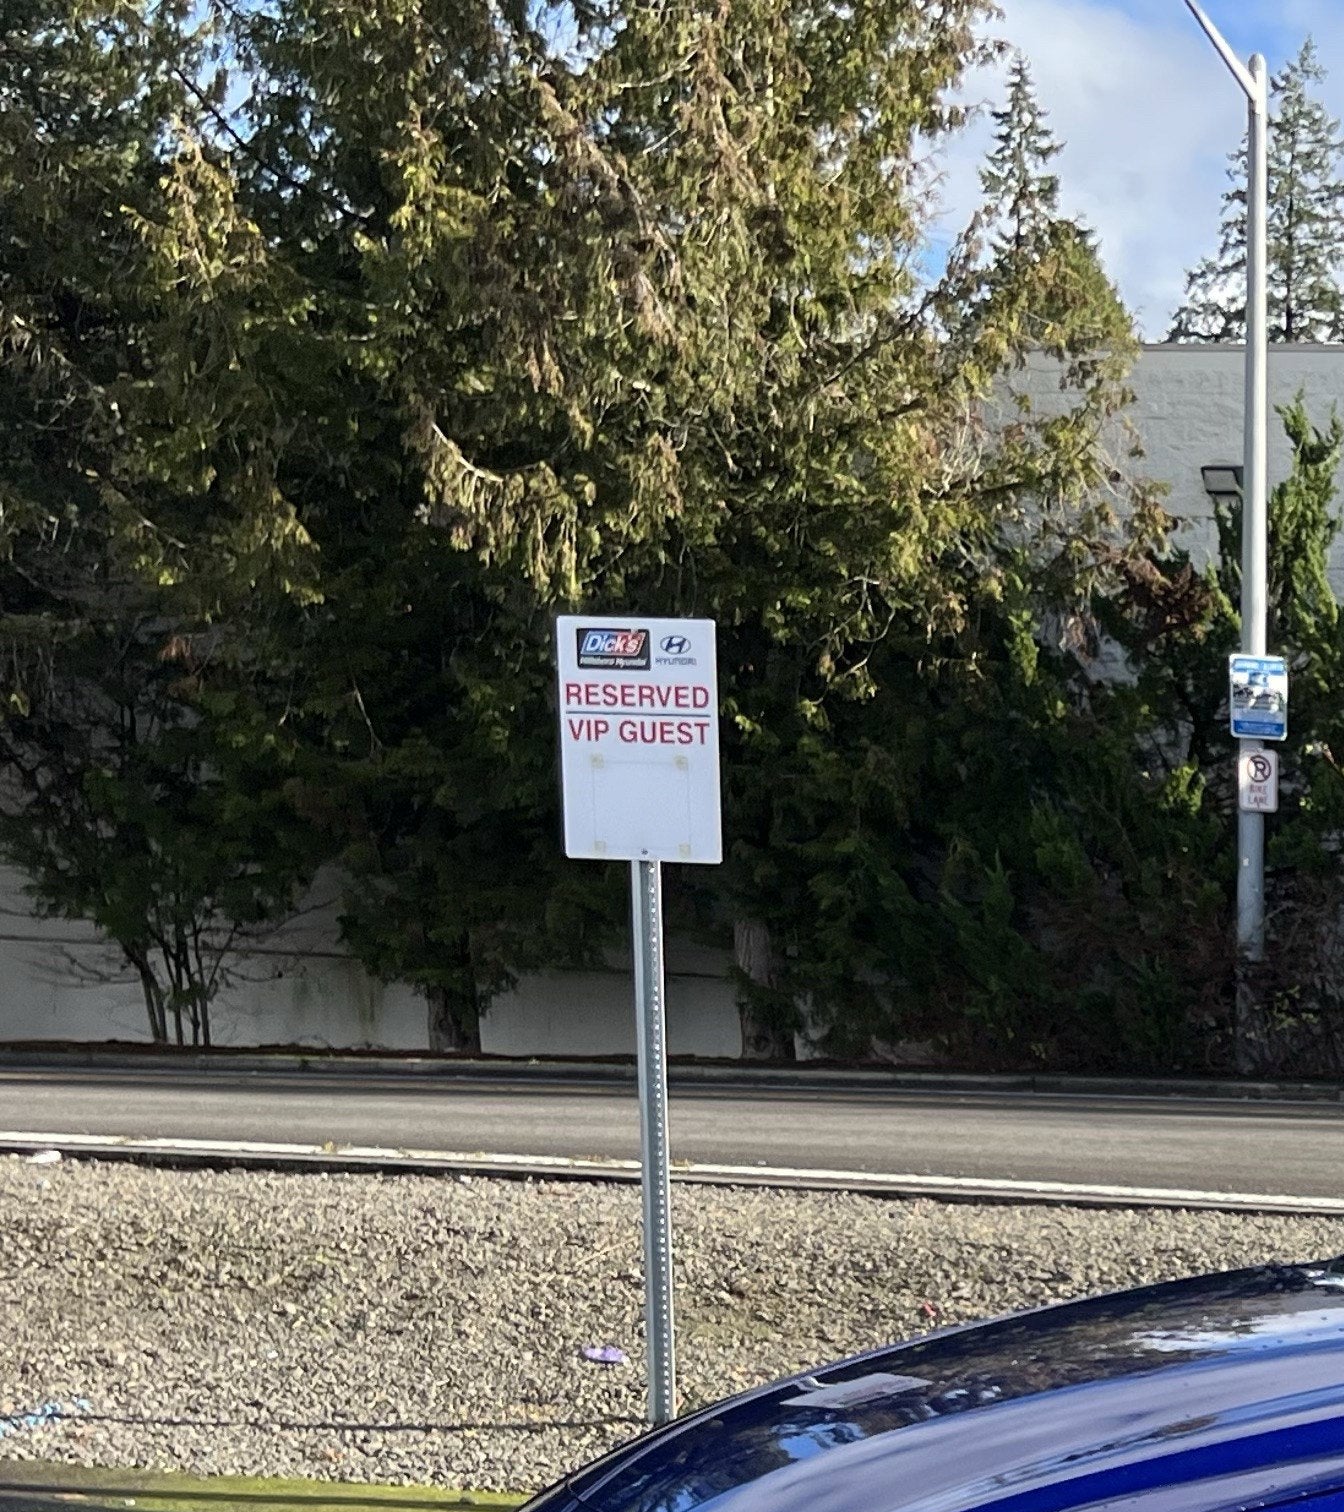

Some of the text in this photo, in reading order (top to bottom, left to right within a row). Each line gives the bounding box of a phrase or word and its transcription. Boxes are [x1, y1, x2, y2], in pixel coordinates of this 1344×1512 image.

[565, 683, 709, 709] RESERVED
[568, 719, 711, 745] VIP GUEST
